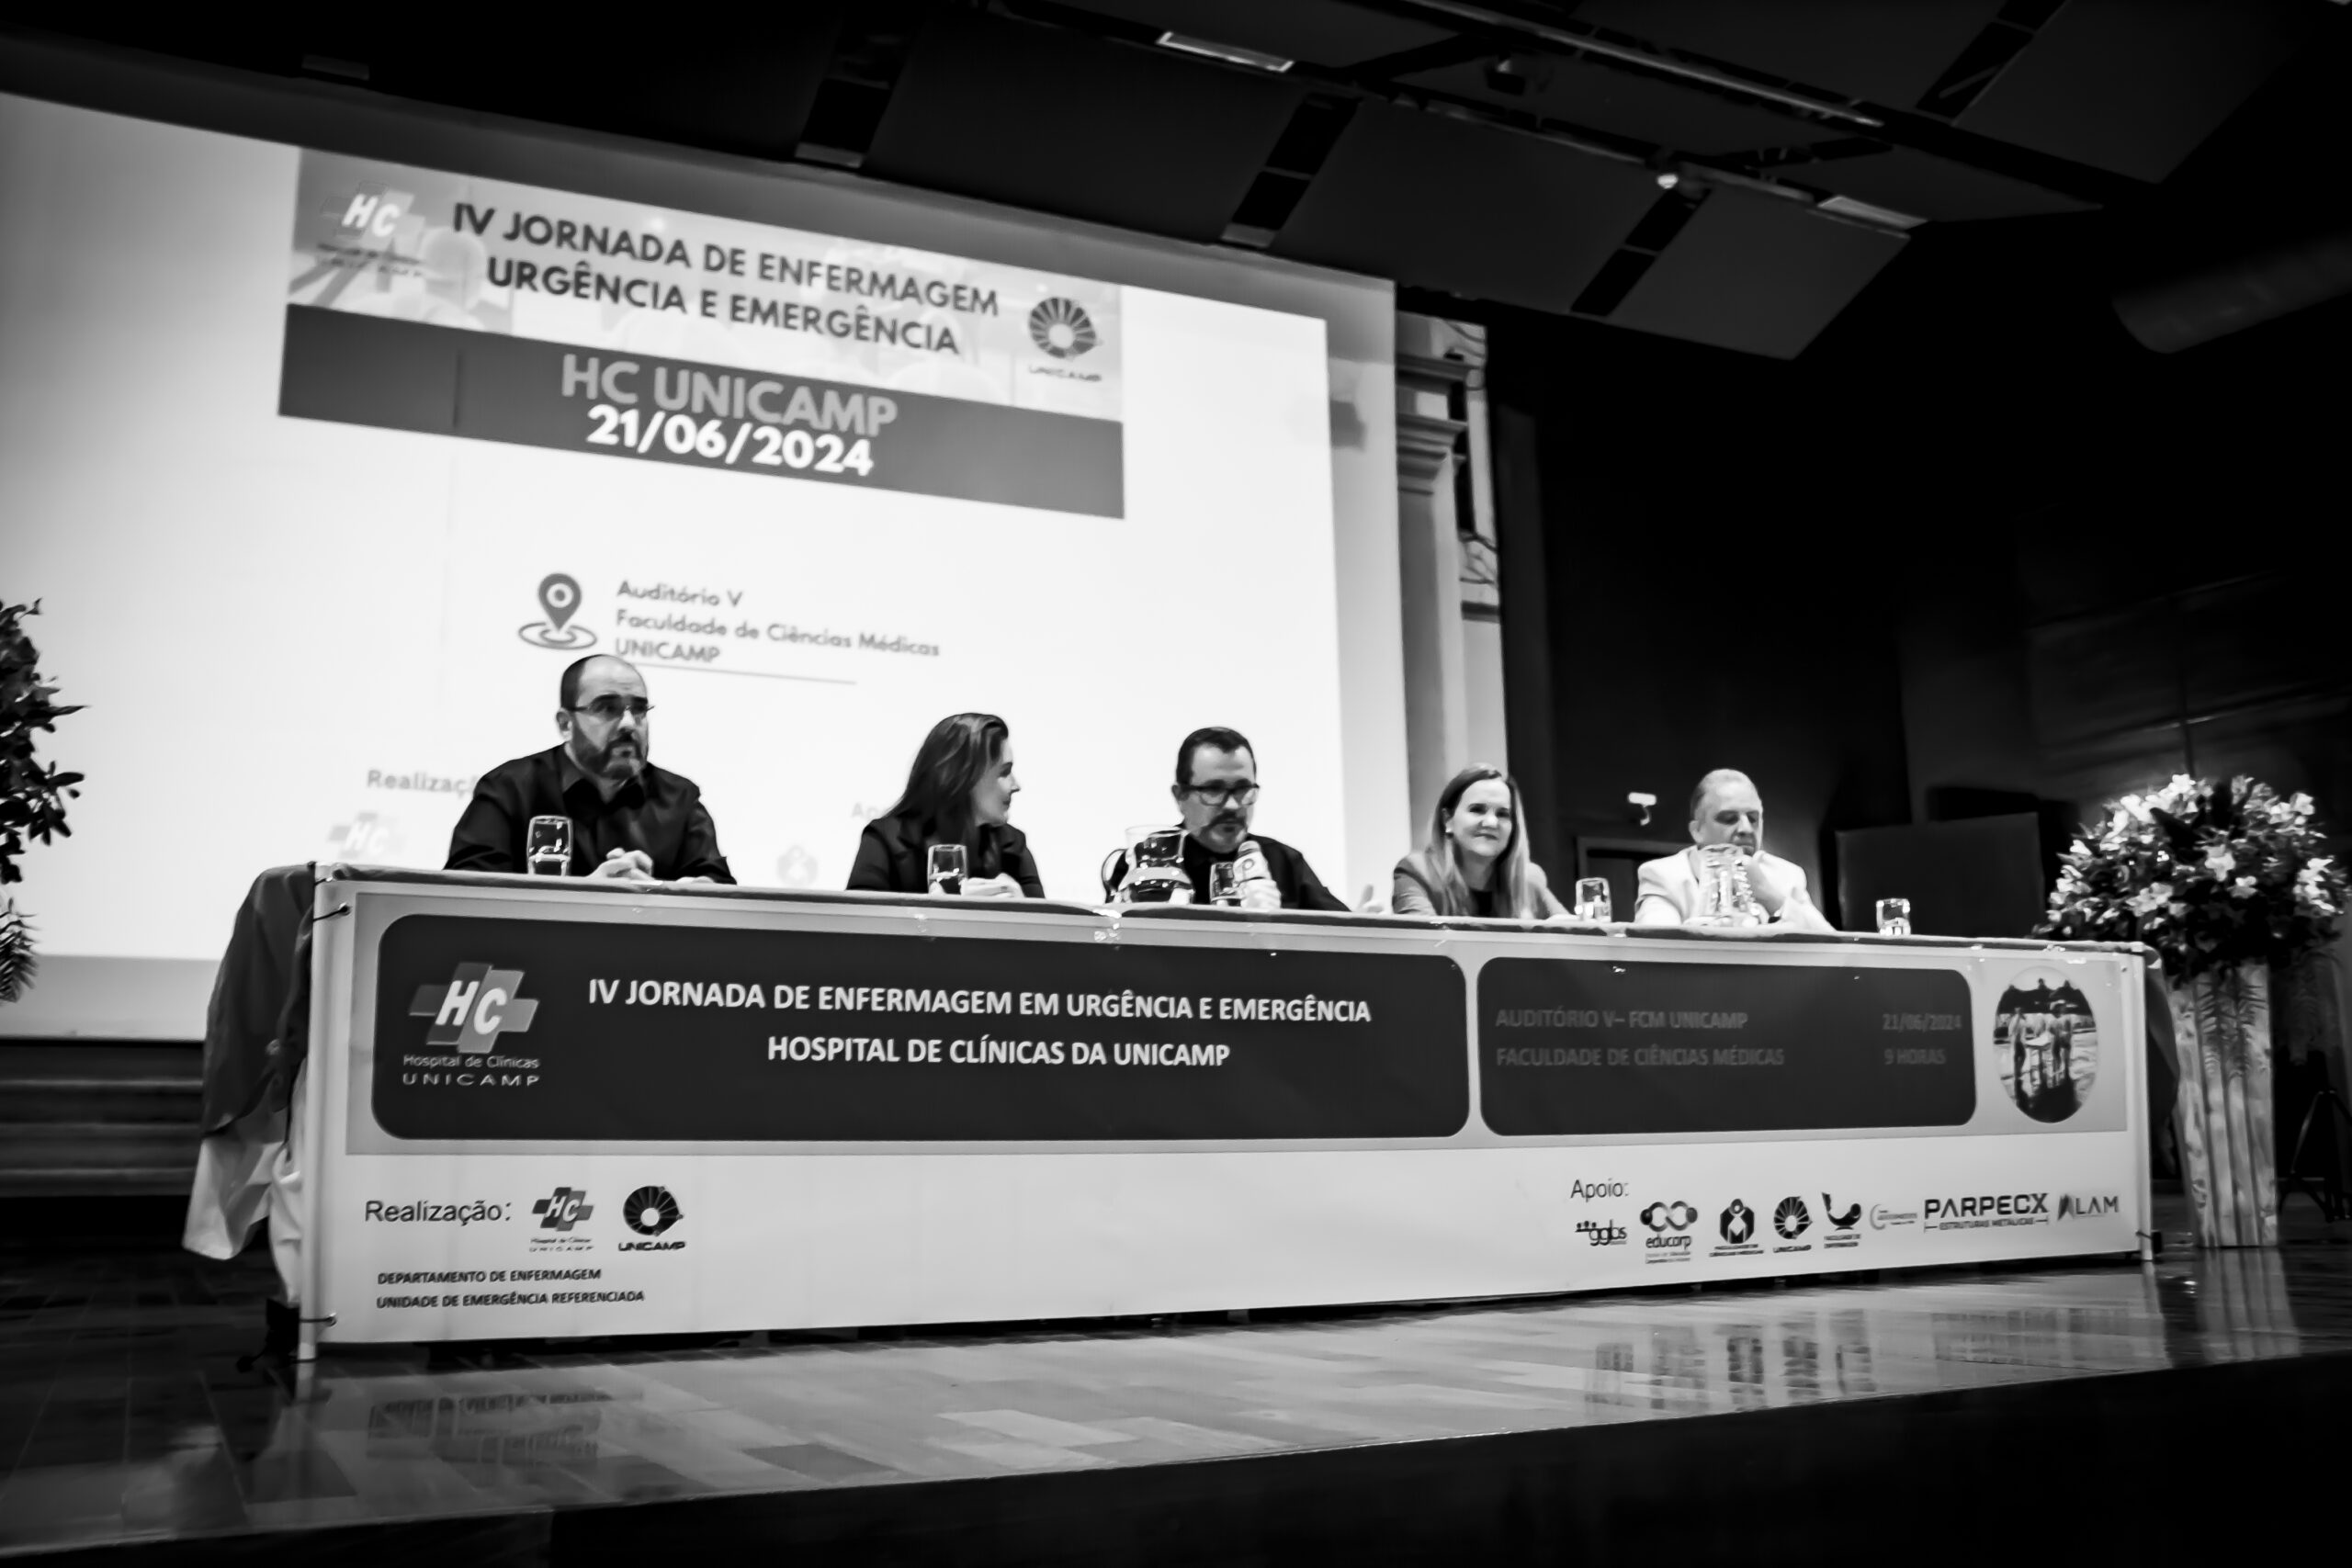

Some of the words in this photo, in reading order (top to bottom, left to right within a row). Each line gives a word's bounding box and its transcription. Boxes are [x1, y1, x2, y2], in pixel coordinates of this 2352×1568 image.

[342, 194, 401, 237] HC
[453, 202, 496, 235] IV
[503, 212, 692, 268] JORNADA
[703, 243, 746, 276] DE
[758, 253, 999, 317] ENFERMAGEM
[487, 257, 687, 316] URGÊNCIA
[699, 289, 718, 318] E
[729, 295, 960, 355] EMERGÊNCIA
[561, 354, 640, 404] HC
[653, 367, 898, 436] UNICAMP
[586, 404, 874, 476] 21/06/2024
[617, 581, 720, 606] Auditório
[729, 591, 742, 607] V
[616, 609, 727, 637] Faculdade
[735, 620, 759, 640] de
[766, 623, 851, 649] Ciências
[859, 634, 940, 657] Médicas
[616, 638, 720, 664] UNICAMP
[435, 980, 506, 1034] HC
[589, 978, 620, 1004] IV
[626, 980, 765, 1009] JORNADA
[774, 985, 809, 1010] DE
[819, 987, 1011, 1014] ENFERMAGEM
[1019, 992, 1059, 1015] EM
[1067, 989, 1193, 1019] URGÊNCIA
[1199, 998, 1212, 1019] E
[1219, 994, 1371, 1022] EMERGÊNCIA
[1496, 1006, 1599, 1028] AUDITÓRIO
[1629, 1011, 1665, 1029] FCM
[1669, 1012, 1748, 1029] UNICAMP
[1883, 1013, 1962, 1031] 21/06/2024
[403, 1055, 460, 1069] Hospital
[465, 1056, 482, 1067] de
[768, 1036, 900, 1062] HOSPITAL
[908, 1039, 943, 1063] DE
[949, 1033, 1065, 1065] CLÍNICAS
[1071, 1042, 1107, 1066] DA
[1114, 1043, 1230, 1066] UNICAMP
[1497, 1048, 1601, 1066] FACULDADE
[1607, 1048, 1630, 1066] DE
[1634, 1043, 1708, 1066] CIÊNCIAS
[1713, 1044, 1785, 1066] MÉDICAS
[1884, 1049, 1893, 1065] 9
[1896, 1049, 1946, 1065] HORAS
[402, 1073, 540, 1087] UNICAMP
[1570, 1178, 1629, 1202] Apoio:
[366, 1200, 512, 1226] Realização:
[545, 1196, 580, 1223] HC
[1925, 1193, 2049, 1219] PARPECX
[617, 1241, 686, 1252] UNICAMP
[1645, 1234, 1691, 1250] educorp
[378, 1270, 486, 1285] DEPARTAMENTO
[490, 1270, 507, 1282] DE
[510, 1269, 602, 1281] ENFERMAGEM
[377, 1294, 438, 1309] UNIDADE
[442, 1294, 459, 1307] DE
[462, 1291, 548, 1306] EMERGÊNCIA
[551, 1291, 645, 1304] REFERENCIADA
